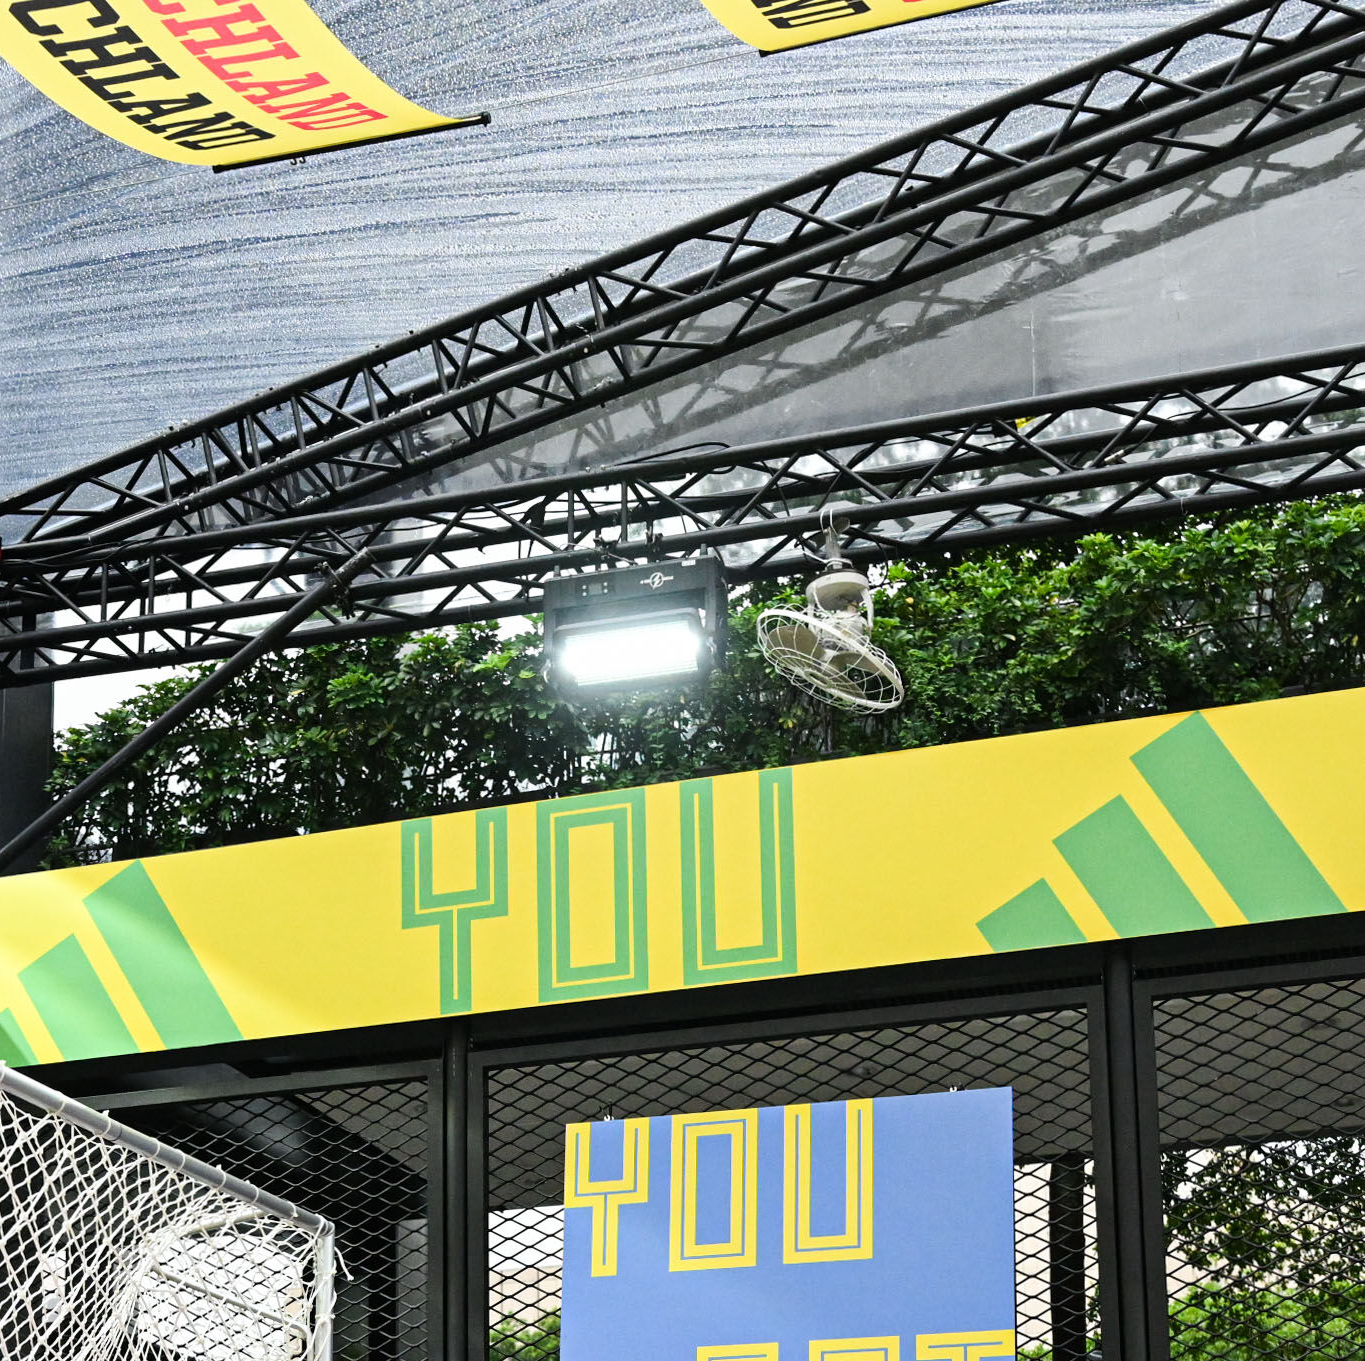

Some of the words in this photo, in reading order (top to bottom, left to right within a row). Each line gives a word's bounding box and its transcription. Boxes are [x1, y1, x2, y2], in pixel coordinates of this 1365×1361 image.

[143, 0, 389, 130] HLAND
[401, 766, 798, 1014] YOU
[564, 1098, 873, 1277] YOU
